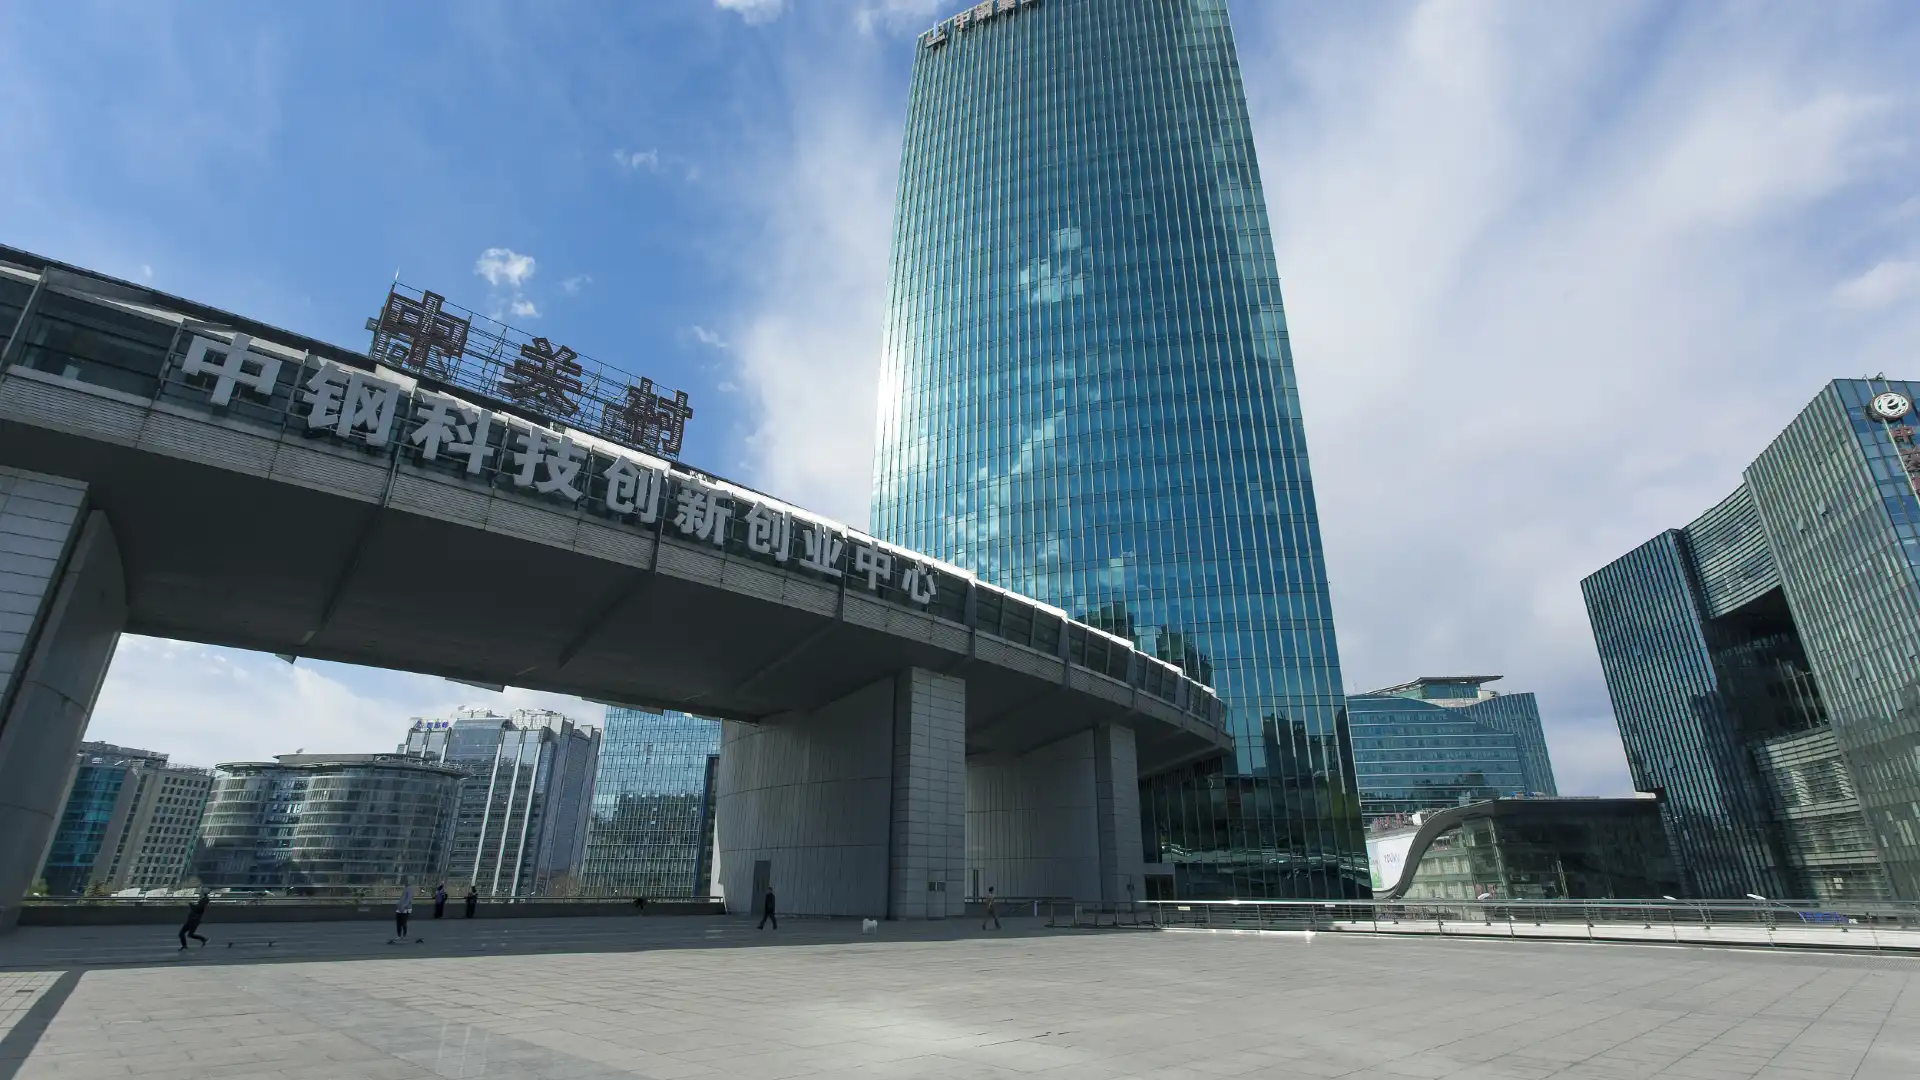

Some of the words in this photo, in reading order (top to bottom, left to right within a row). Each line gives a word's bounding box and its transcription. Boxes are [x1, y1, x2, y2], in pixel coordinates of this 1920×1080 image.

[181, 332, 937, 604] 中钢科技创新创业中心
